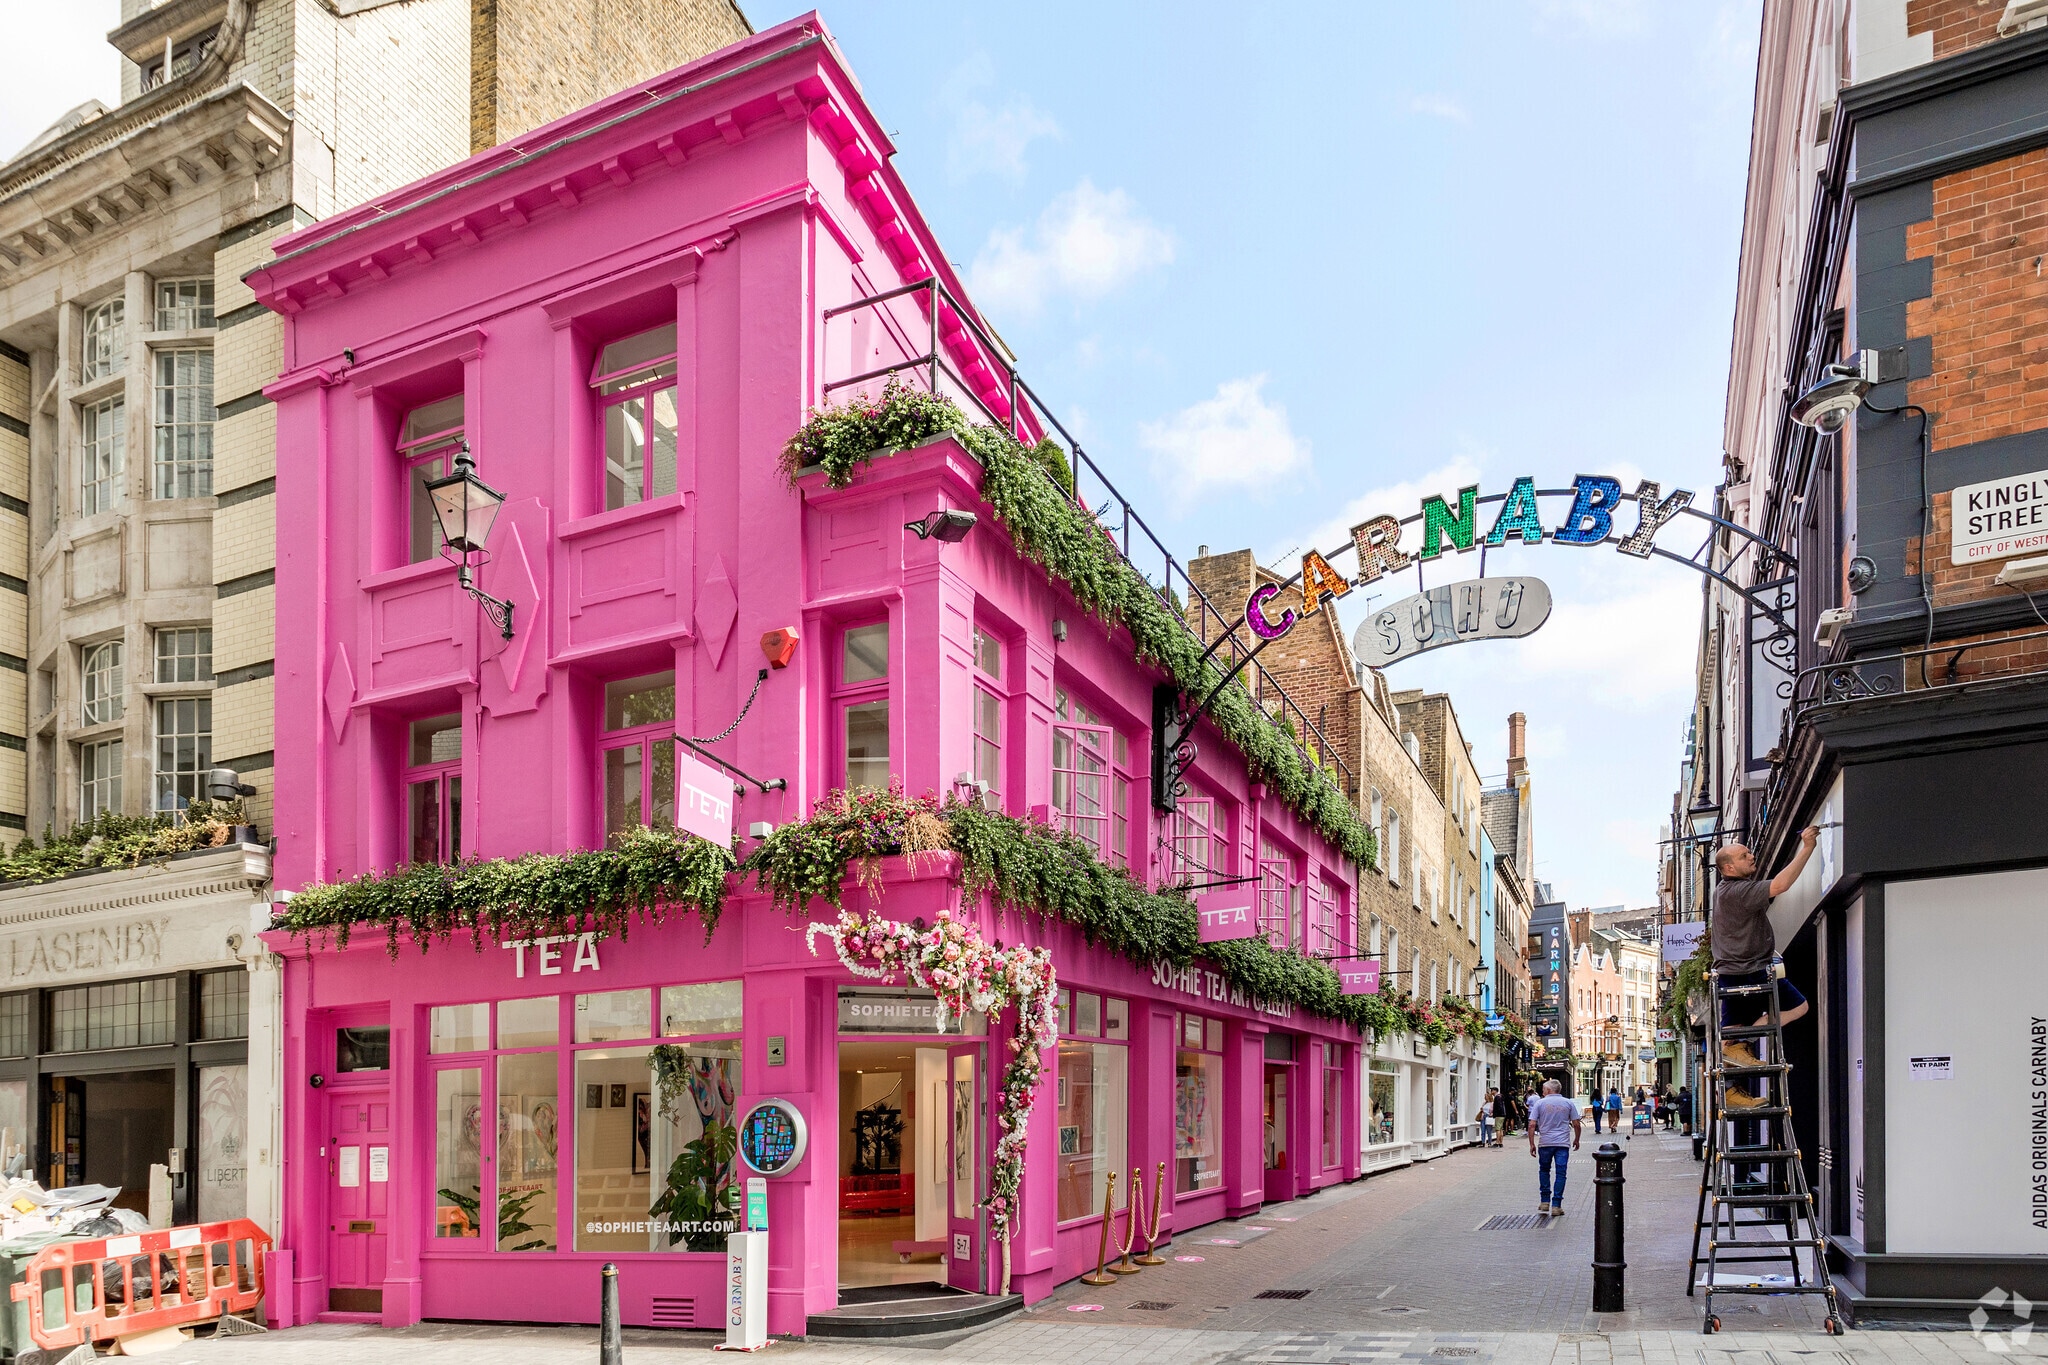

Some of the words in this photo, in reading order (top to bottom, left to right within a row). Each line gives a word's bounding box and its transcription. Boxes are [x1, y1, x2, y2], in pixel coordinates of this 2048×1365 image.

[1968, 502, 2048, 535] STREE
[1244, 473, 1696, 640] CARNABY
[1968, 544, 1993, 557] CITY
[1997, 540, 2011, 552] OF
[2014, 534, 2048, 549] WEST
[1375, 581, 1524, 655] SOHO
[683, 781, 730, 825] TEA
[1201, 905, 1251, 927] TEA
[9, 915, 170, 981] LASENBY
[502, 931, 609, 979] TEA
[1550, 926, 1561, 1005] CARNABY
[1151, 957, 1202, 996] SOPHIE
[1204, 970, 1228, 1003] TEA
[1341, 972, 1377, 984] TEA
[2031, 1016, 2047, 1087] CARNABY
[2032, 1090, 2048, 1170] ORIGINALS
[207, 1168, 247, 1187] LIBERT
[2032, 1174, 2048, 1229] ADIDAS
[731, 1255, 743, 1327] CARNABY
